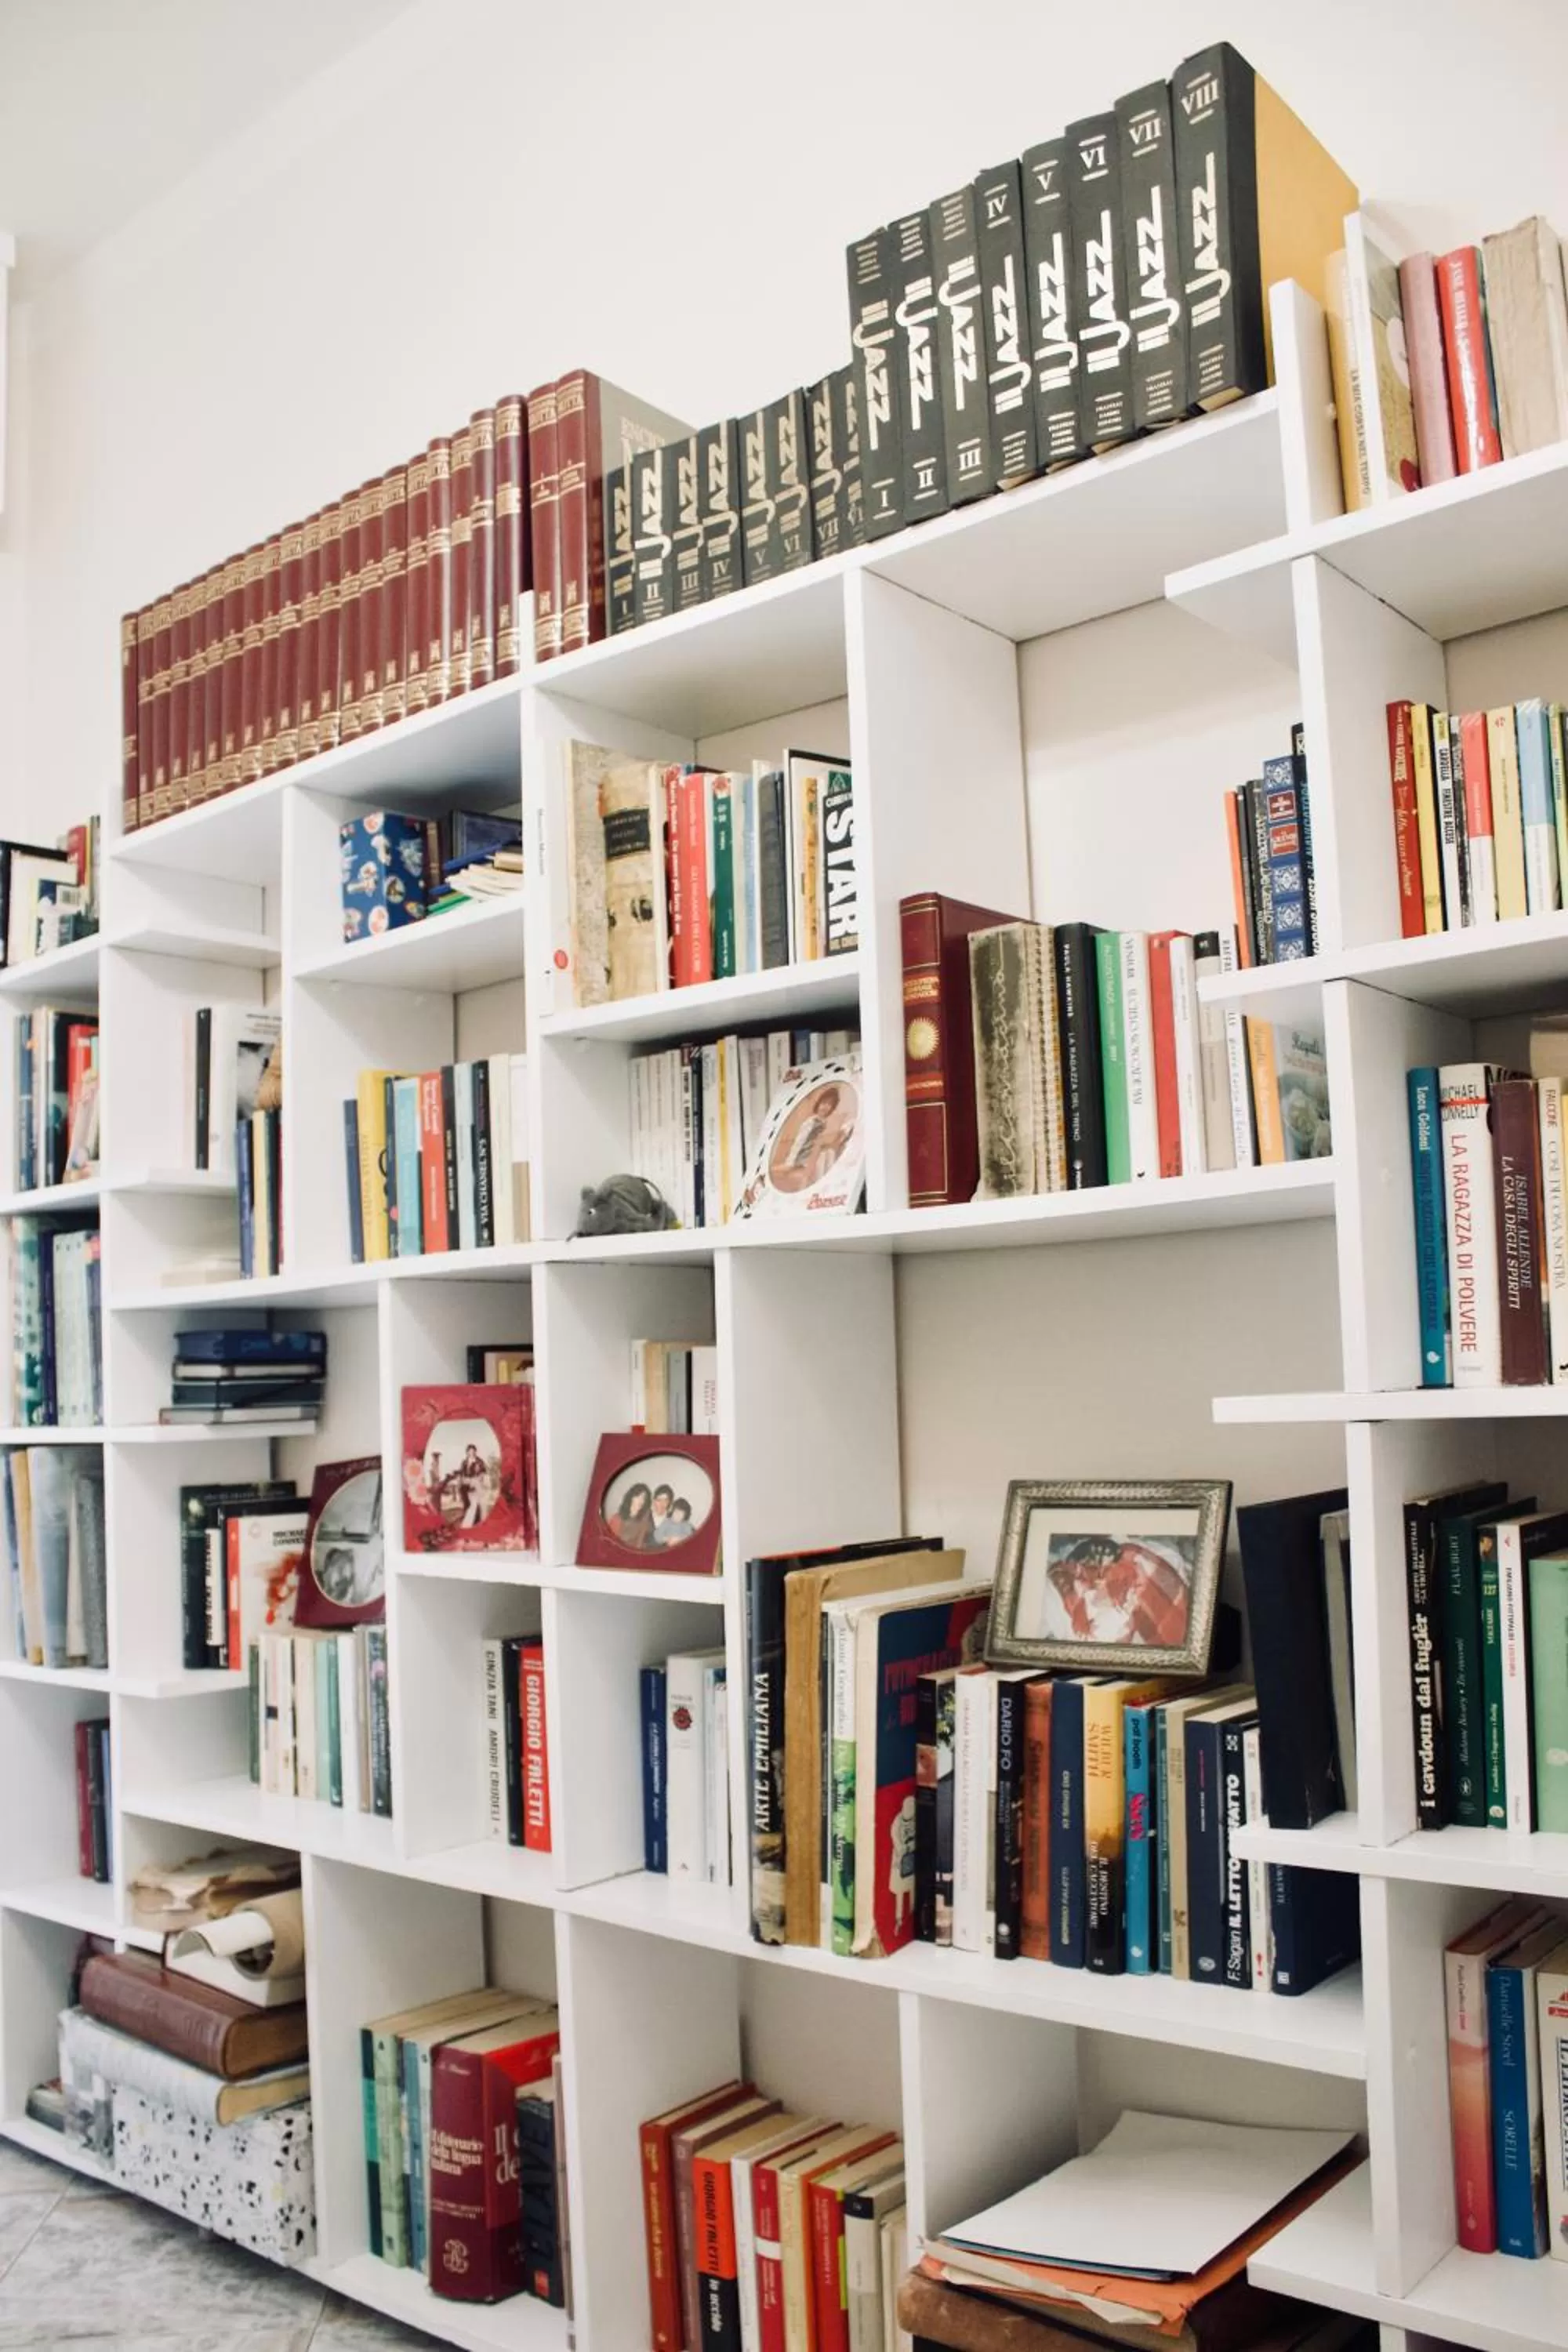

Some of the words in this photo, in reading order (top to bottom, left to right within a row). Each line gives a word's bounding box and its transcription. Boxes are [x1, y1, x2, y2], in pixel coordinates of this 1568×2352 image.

[1181, 79, 1220, 115] VIII
[1129, 118, 1162, 147] VII
[1080, 145, 1108, 168] VI
[1037, 171, 1053, 191] V
[986, 195, 1007, 219] IV
[959, 447, 982, 469] III
[917, 469, 934, 488] II
[880, 491, 889, 507] I
[1063, 943, 1072, 972] PAULA
[1065, 975, 1075, 1018] HAWKINS
[1067, 1032, 1075, 1045] LA
[1069, 1047, 1078, 1089] RAGAZZA
[1071, 1092, 1080, 1109] DEL
[1073, 1112, 1082, 1141] TRENO
[1450, 1134, 1468, 1157] LA
[1501, 1156, 1515, 1172] LA
[1453, 1163, 1472, 1246] RAGAZZA
[1503, 1176, 1517, 1208] CASA
[1515, 1175, 1528, 1221] ISABEL
[477, 1204, 490, 1225] VIA
[1504, 1214, 1519, 1256] DEGLI
[1456, 1254, 1474, 1269] DI
[1518, 1225, 1532, 1290] ALLENDE
[1507, 1258, 1522, 1310] SPIRITI
[1458, 1277, 1477, 1352] POLVERE
[1449, 1535, 1462, 1595] FLAUBERT
[1412, 1613, 1432, 1673] fuglèr
[485, 1650, 496, 1691] CINZIA
[488, 1694, 498, 1719] TANI
[525, 1674, 543, 1750] GIORGIO
[1415, 1676, 1432, 1708] dal
[753, 1672, 771, 1773] EMILIANA
[1000, 1697, 1013, 1745] DARIO
[1132, 1718, 1142, 1736] pat
[1000, 1748, 1013, 1770] FO
[1087, 1722, 1099, 1777] SMITH
[1100, 1725, 1112, 1779] WILBUR
[1417, 1713, 1435, 1795] cavdoun
[526, 1753, 545, 1828] FALETTI
[753, 1780, 770, 1831] ARTE
[1226, 1859, 1241, 1912] LETTO
[1227, 1915, 1241, 1929] IL
[1502, 2109, 1518, 2171] SORELLE
[704, 2171, 717, 2220] GIORGIO
[711, 2292, 724, 2332] uccido
